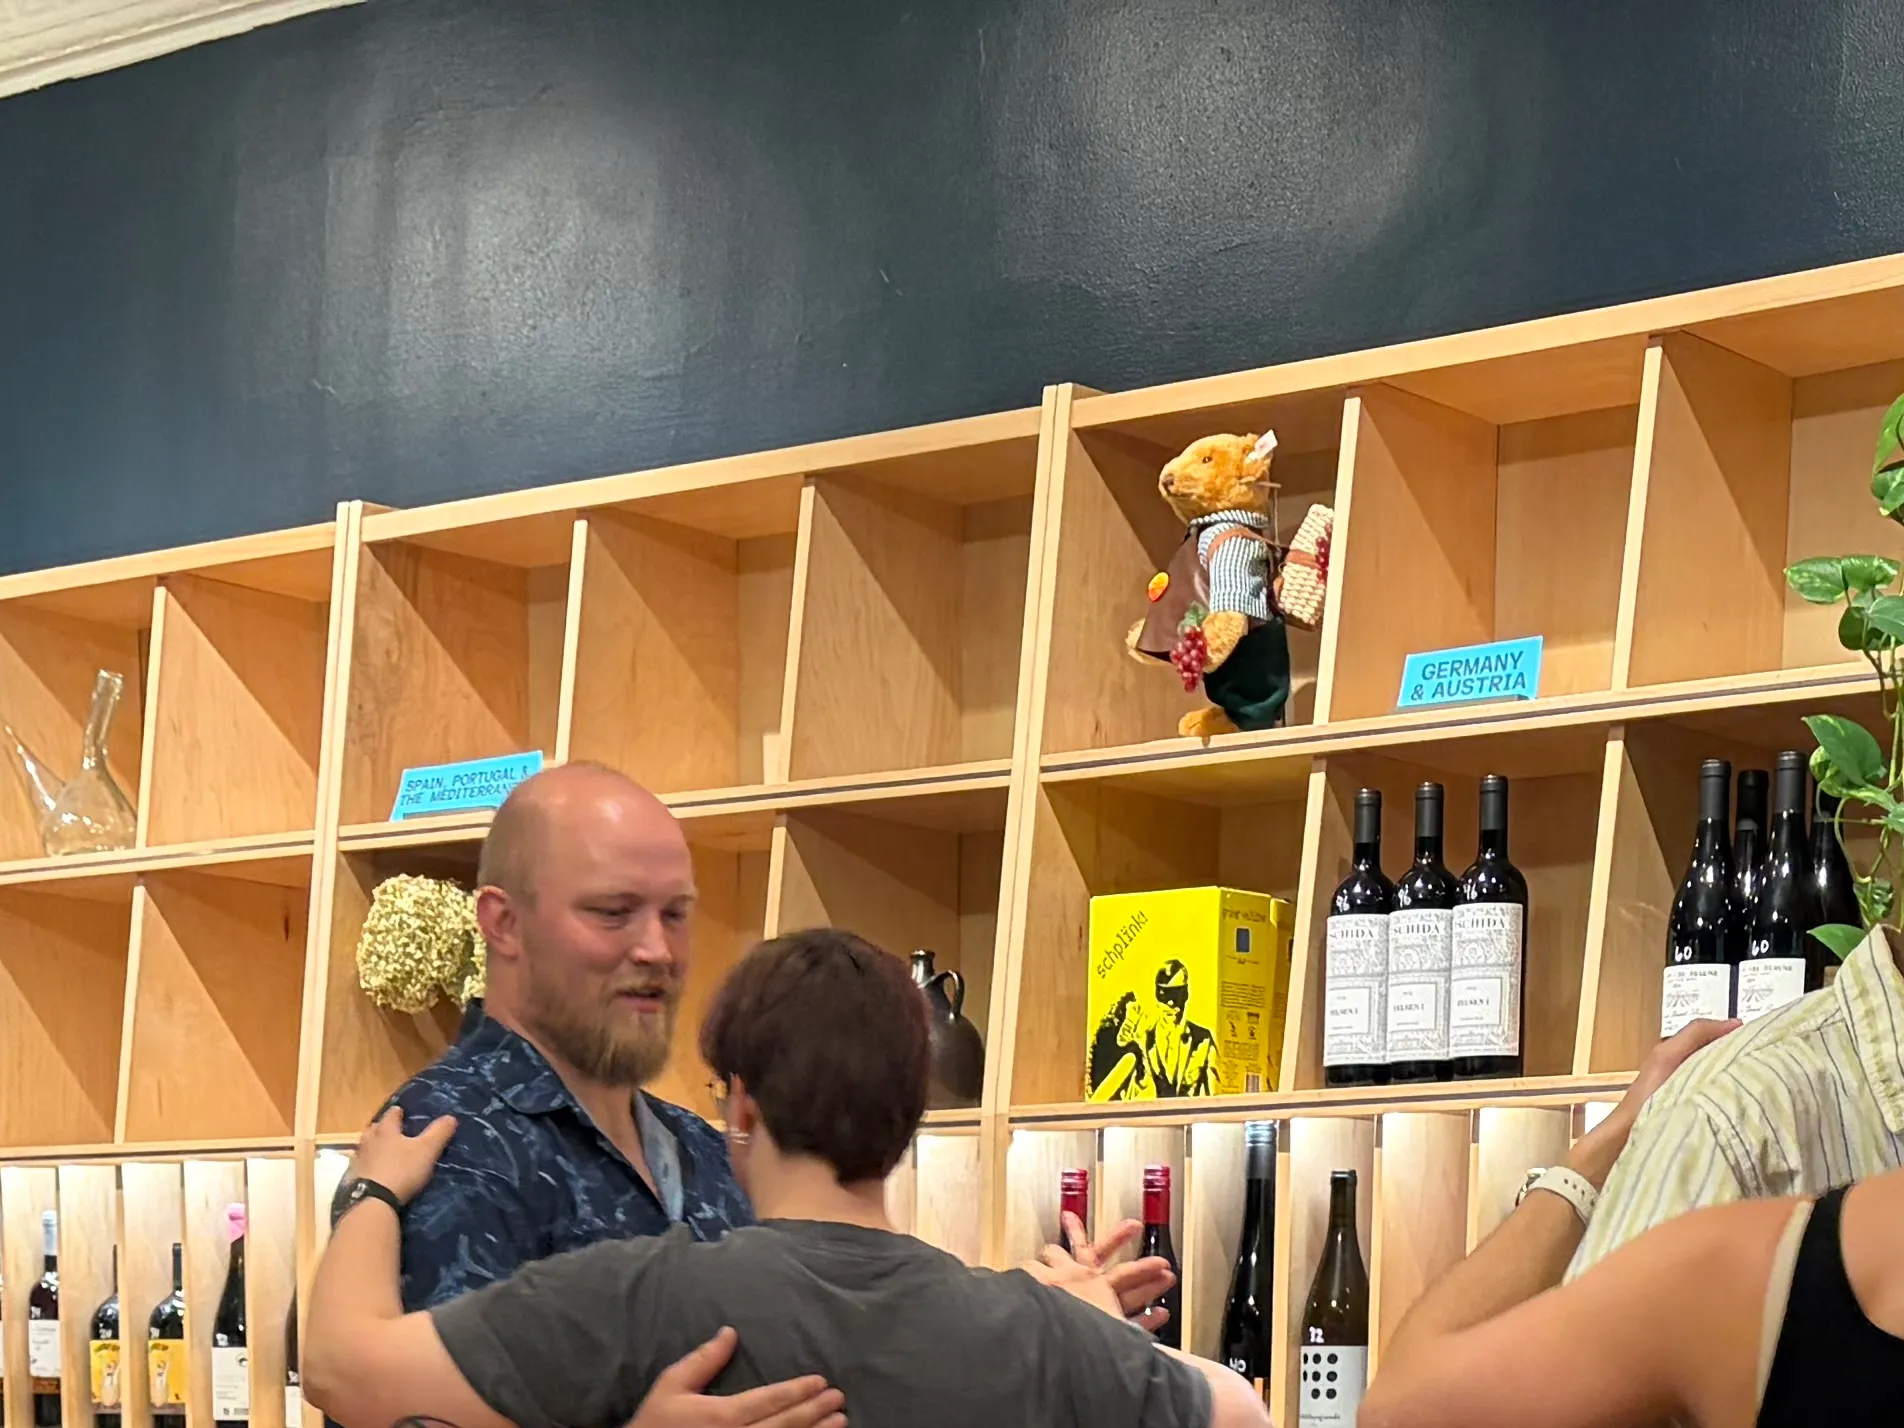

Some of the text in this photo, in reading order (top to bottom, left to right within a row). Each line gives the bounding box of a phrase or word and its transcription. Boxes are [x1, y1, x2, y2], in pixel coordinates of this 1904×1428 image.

[1421, 651, 1524, 682] GERMANY
[1410, 671, 1528, 701] & AUSTRIA
[452, 768, 514, 788] PORTUGAL
[400, 791, 424, 806] THE
[1675, 946, 1693, 962] 60
[1752, 939, 1769, 957] 60
